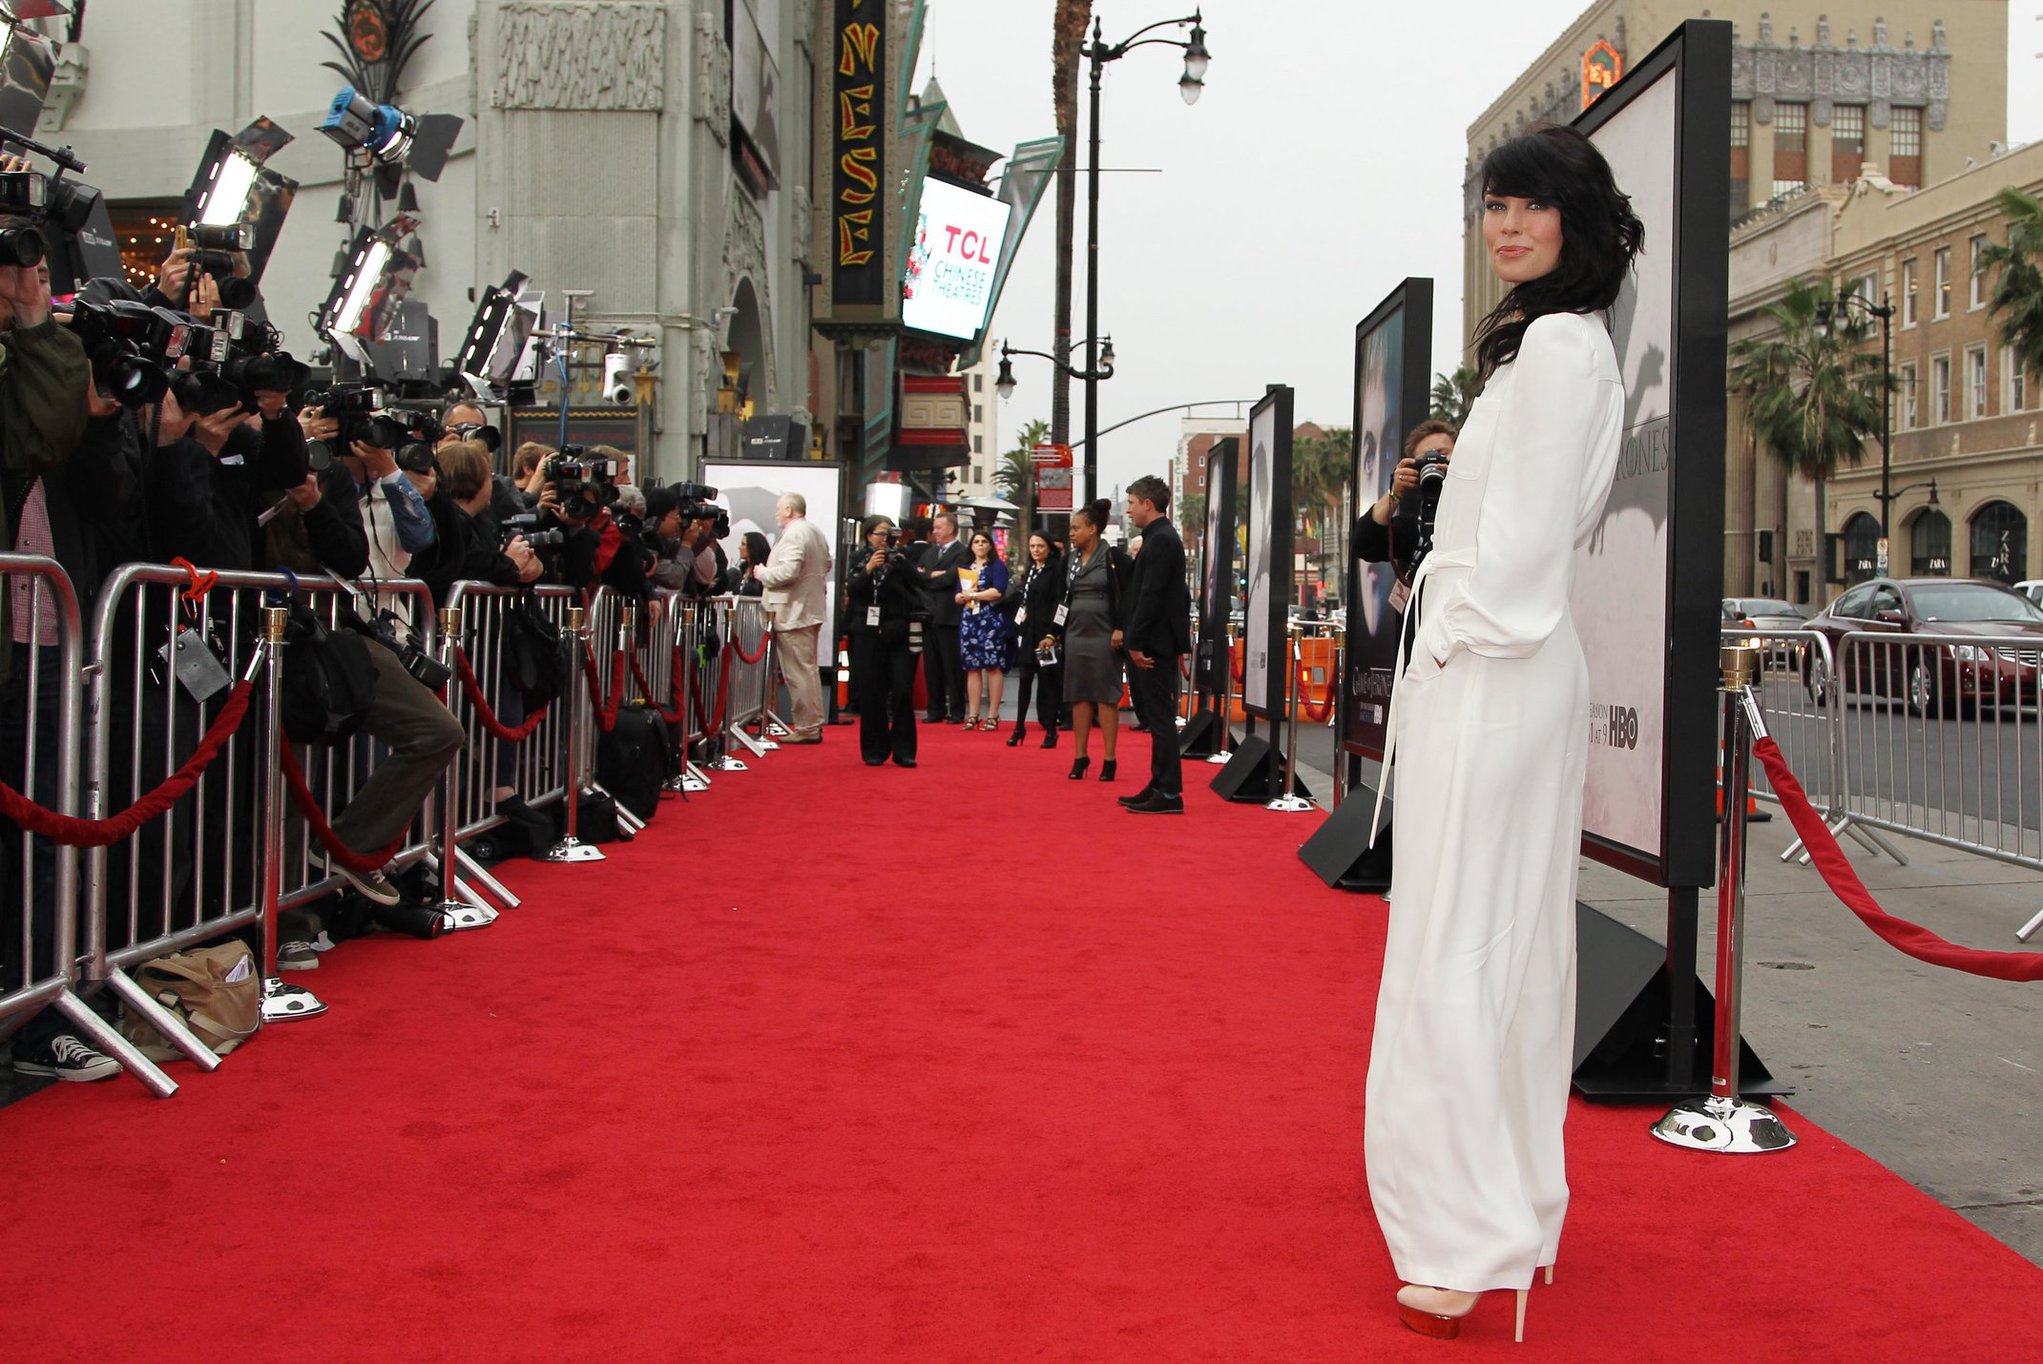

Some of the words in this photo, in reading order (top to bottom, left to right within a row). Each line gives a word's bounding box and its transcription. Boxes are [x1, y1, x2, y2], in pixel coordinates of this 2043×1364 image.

[839, 0, 880, 267] NESE
[945, 224, 990, 265] TCL
[934, 260, 987, 289] CHINESE
[1616, 425, 1669, 481] RONES
[1858, 560, 1872, 570] ZARA
[1930, 558, 1946, 569] ZARA
[2000, 530, 2010, 575] ZARA
[1590, 702, 1608, 719] EASON
[1609, 705, 1638, 750] HBO
[1602, 723, 1608, 745] 9
